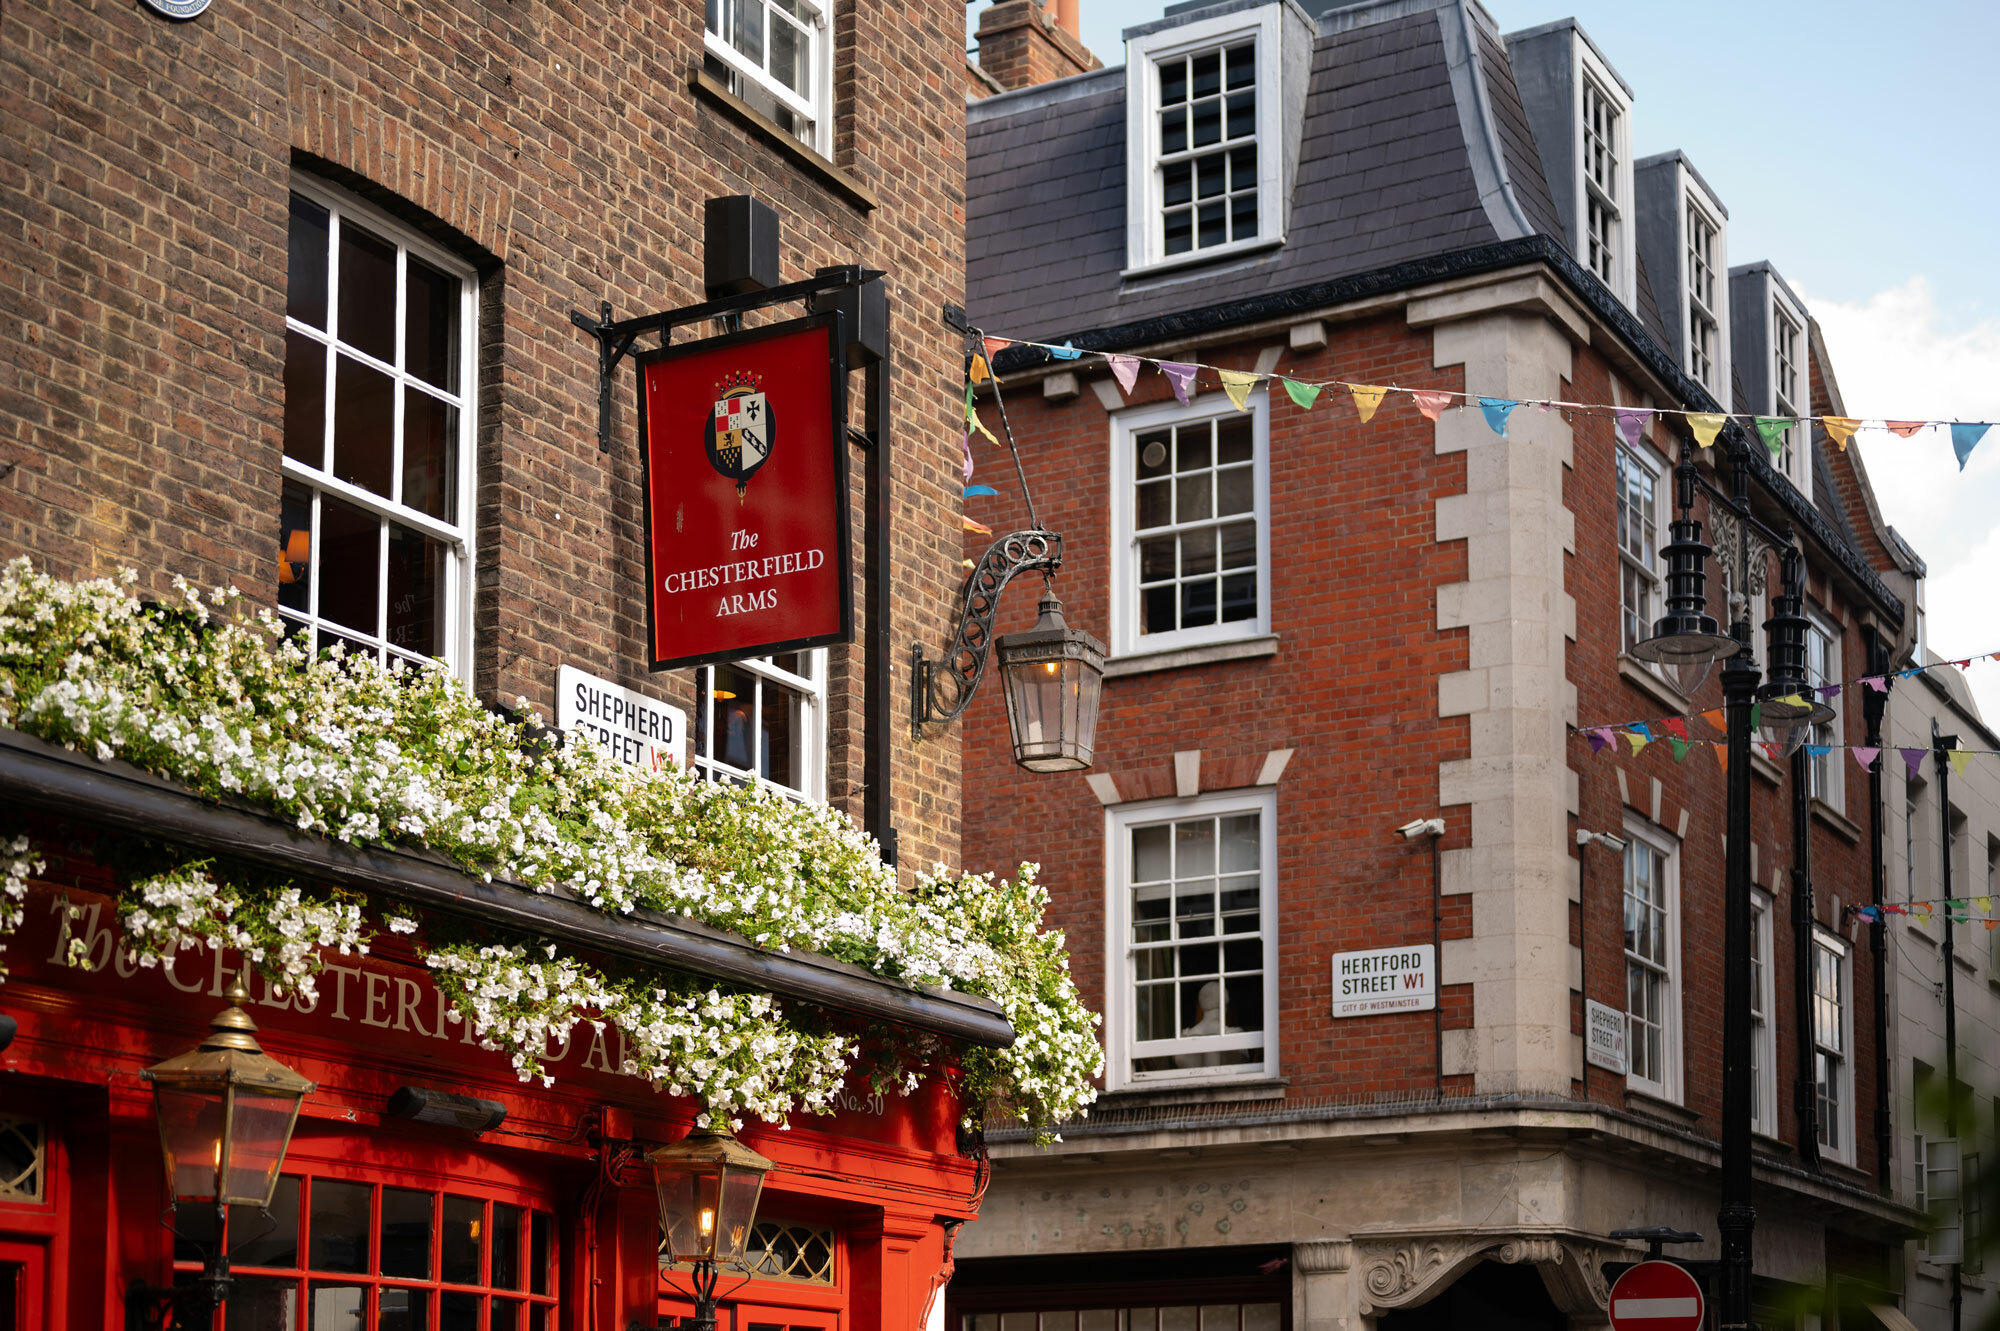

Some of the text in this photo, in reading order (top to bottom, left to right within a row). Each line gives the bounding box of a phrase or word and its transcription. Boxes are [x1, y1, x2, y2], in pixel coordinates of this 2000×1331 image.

[731, 529, 758, 551] The
[664, 549, 824, 594] CHESTERFIELD
[716, 588, 777, 617] ARMS
[575, 683, 673, 744] SHEPHERD
[1341, 952, 1421, 975] HERTFORD
[1342, 972, 1424, 995] STREET W1
[1342, 999, 1420, 1012] CITY OF WESTMINSTER
[1591, 1008, 1622, 1033] SHEPHERD
[1591, 1027, 1623, 1052] STREET W1
[866, 1093, 884, 1116] 50
